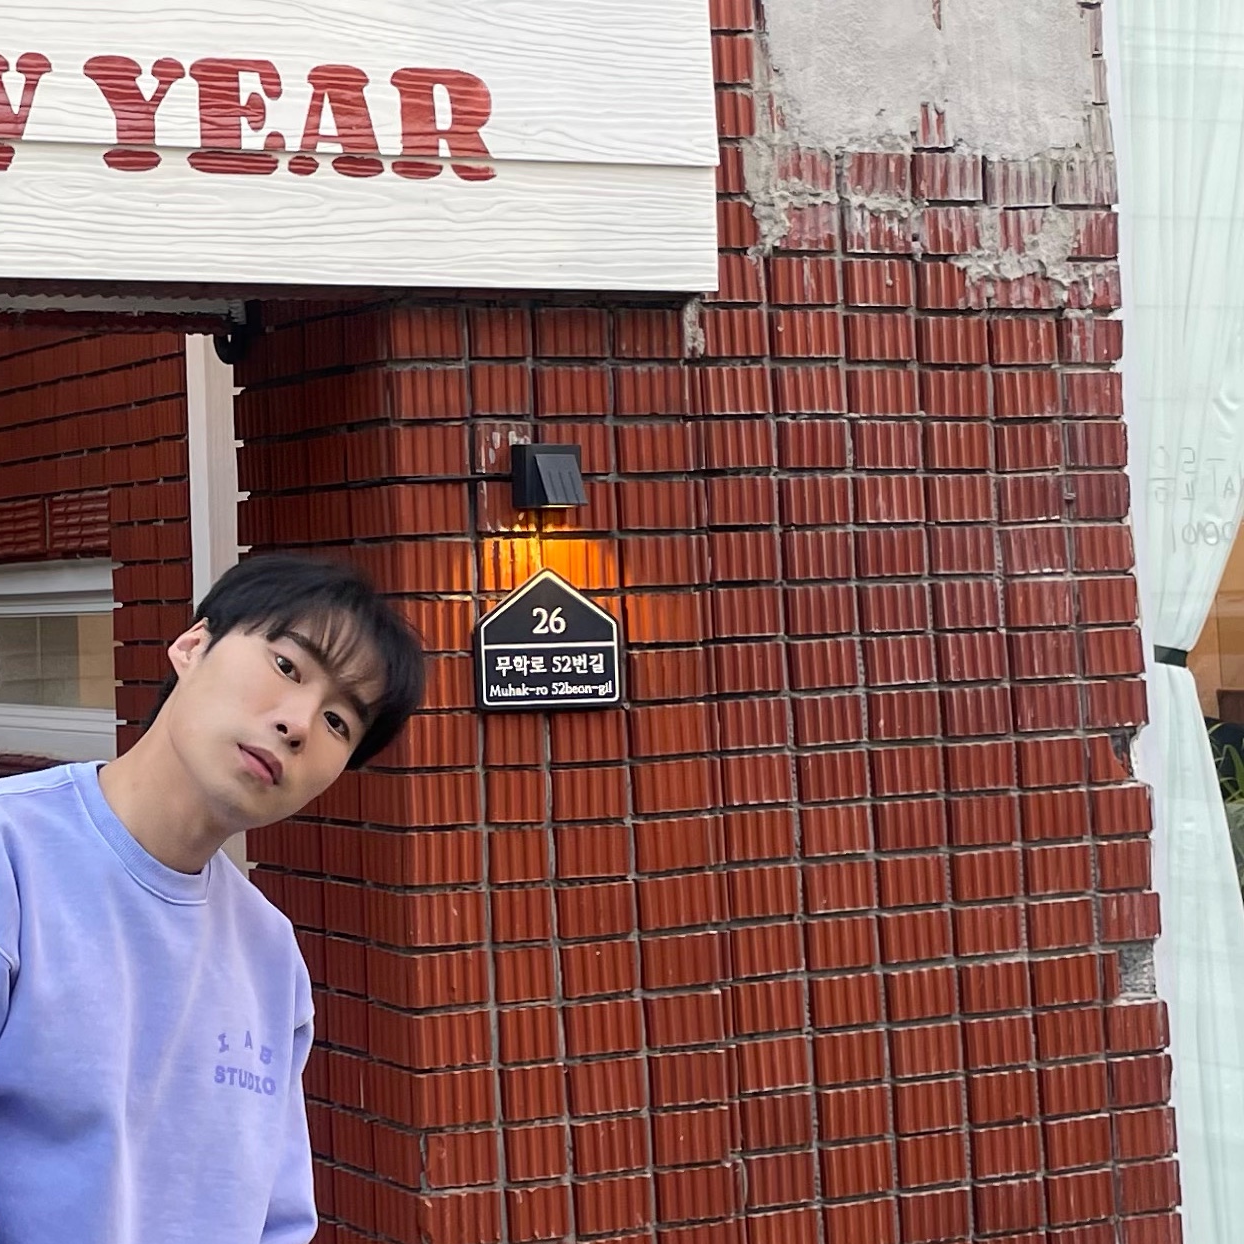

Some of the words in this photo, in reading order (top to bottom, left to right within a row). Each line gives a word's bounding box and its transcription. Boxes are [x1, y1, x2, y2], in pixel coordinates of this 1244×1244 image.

[82, 55, 497, 182] YEAR
[532, 607, 567, 634] 26
[495, 655, 547, 677] 무학로
[552, 653, 605, 674] 52번길
[489, 683, 548, 697] Muhak-ro
[551, 680, 613, 695] 52beon-gil
[214, 1065, 276, 1096] STUDIO
